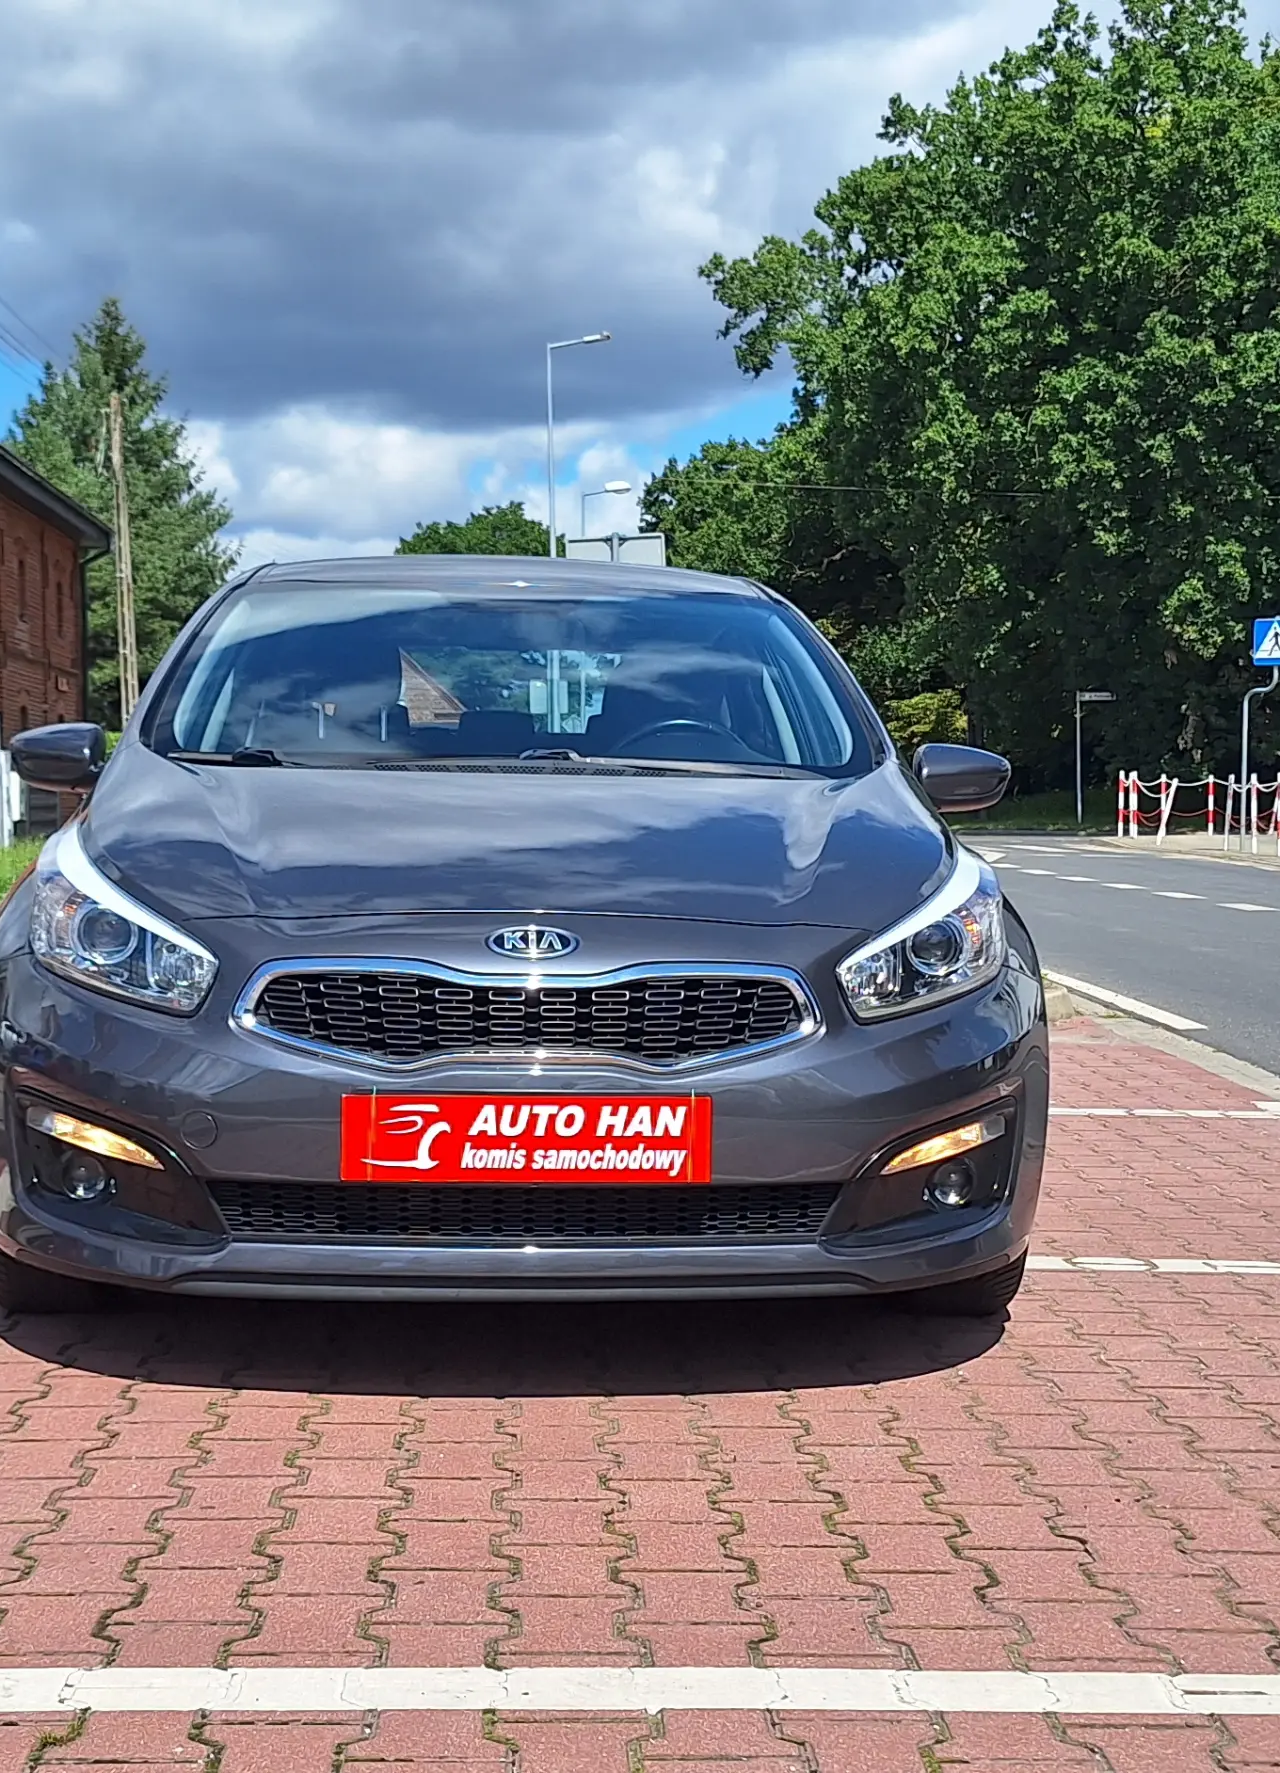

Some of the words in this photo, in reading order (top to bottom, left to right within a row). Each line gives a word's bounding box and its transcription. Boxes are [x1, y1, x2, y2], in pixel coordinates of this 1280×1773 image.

[503, 931, 562, 950] KIA
[468, 1104, 585, 1137] AUTO
[595, 1105, 688, 1137] HAN
[460, 1142, 527, 1169] komis
[531, 1143, 688, 1177] samochodowy
